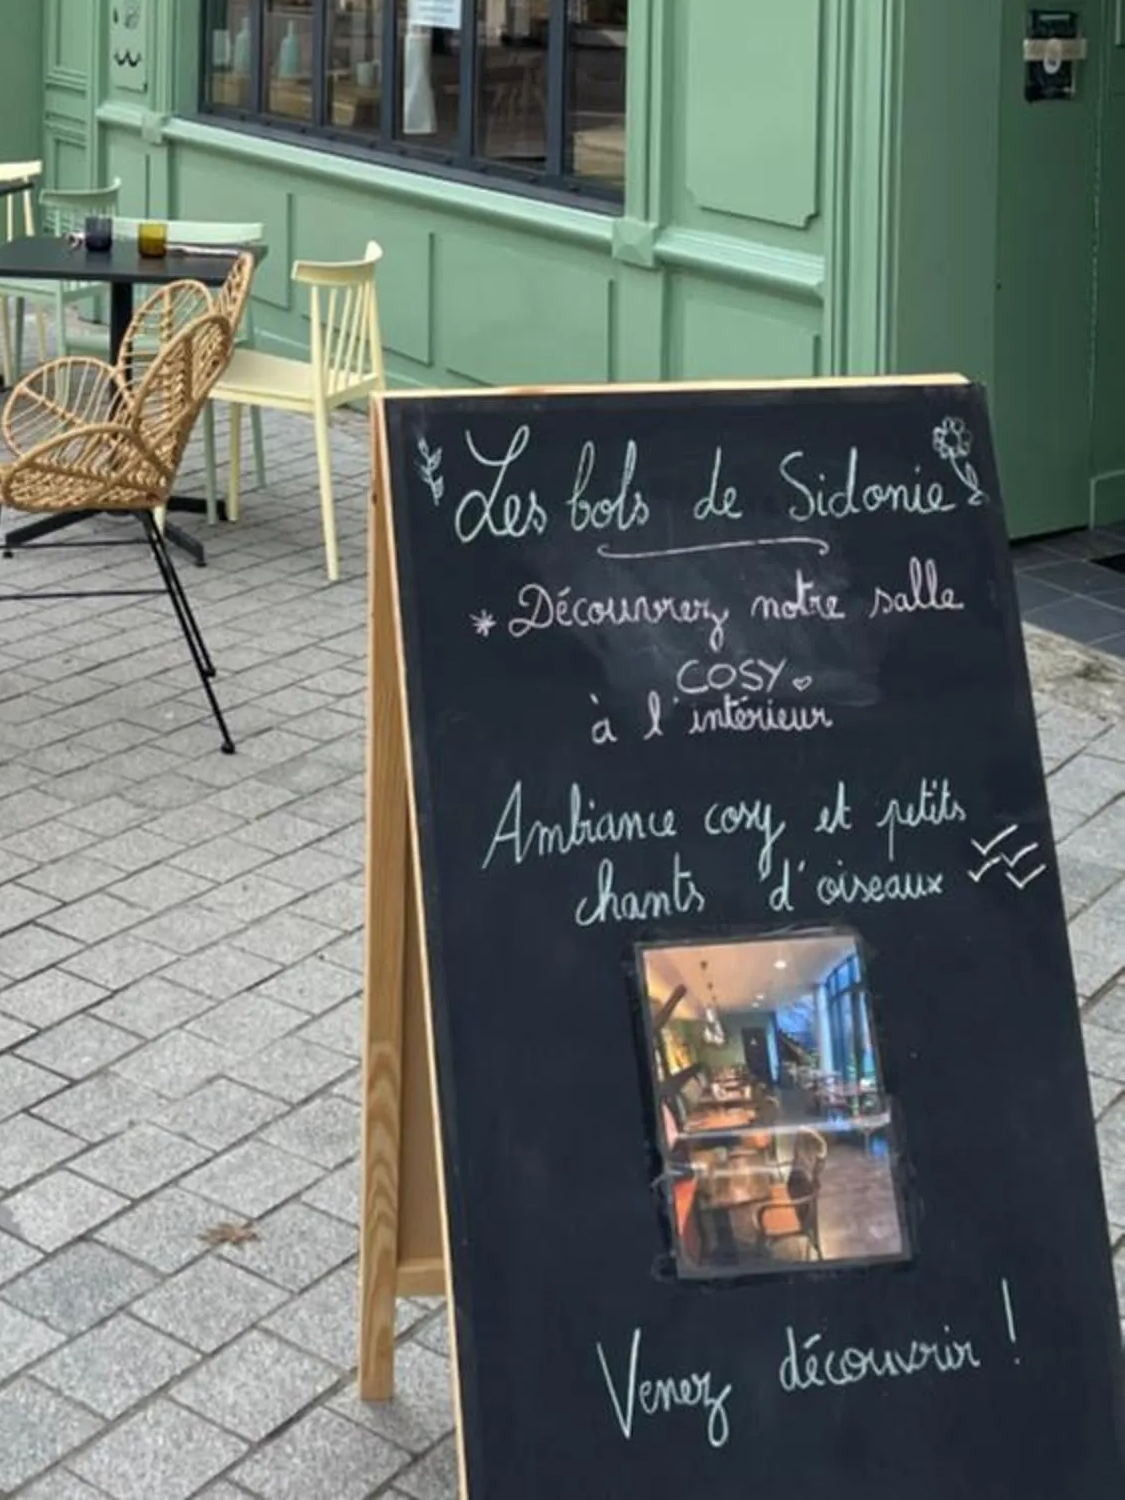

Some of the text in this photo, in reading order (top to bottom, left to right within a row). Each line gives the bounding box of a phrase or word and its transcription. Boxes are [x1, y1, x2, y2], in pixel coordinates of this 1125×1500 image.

[454, 424, 957, 543] Les bols de Sidonie
[508, 556, 965, 652] Découvrez notre salle
[590, 693, 618, 745] à
[481, 777, 967, 882] Ambiance cosy et petits
[575, 852, 706, 926] chants
[596, 1327, 732, 1448] Venez
[779, 1325, 981, 1391] découvrir
